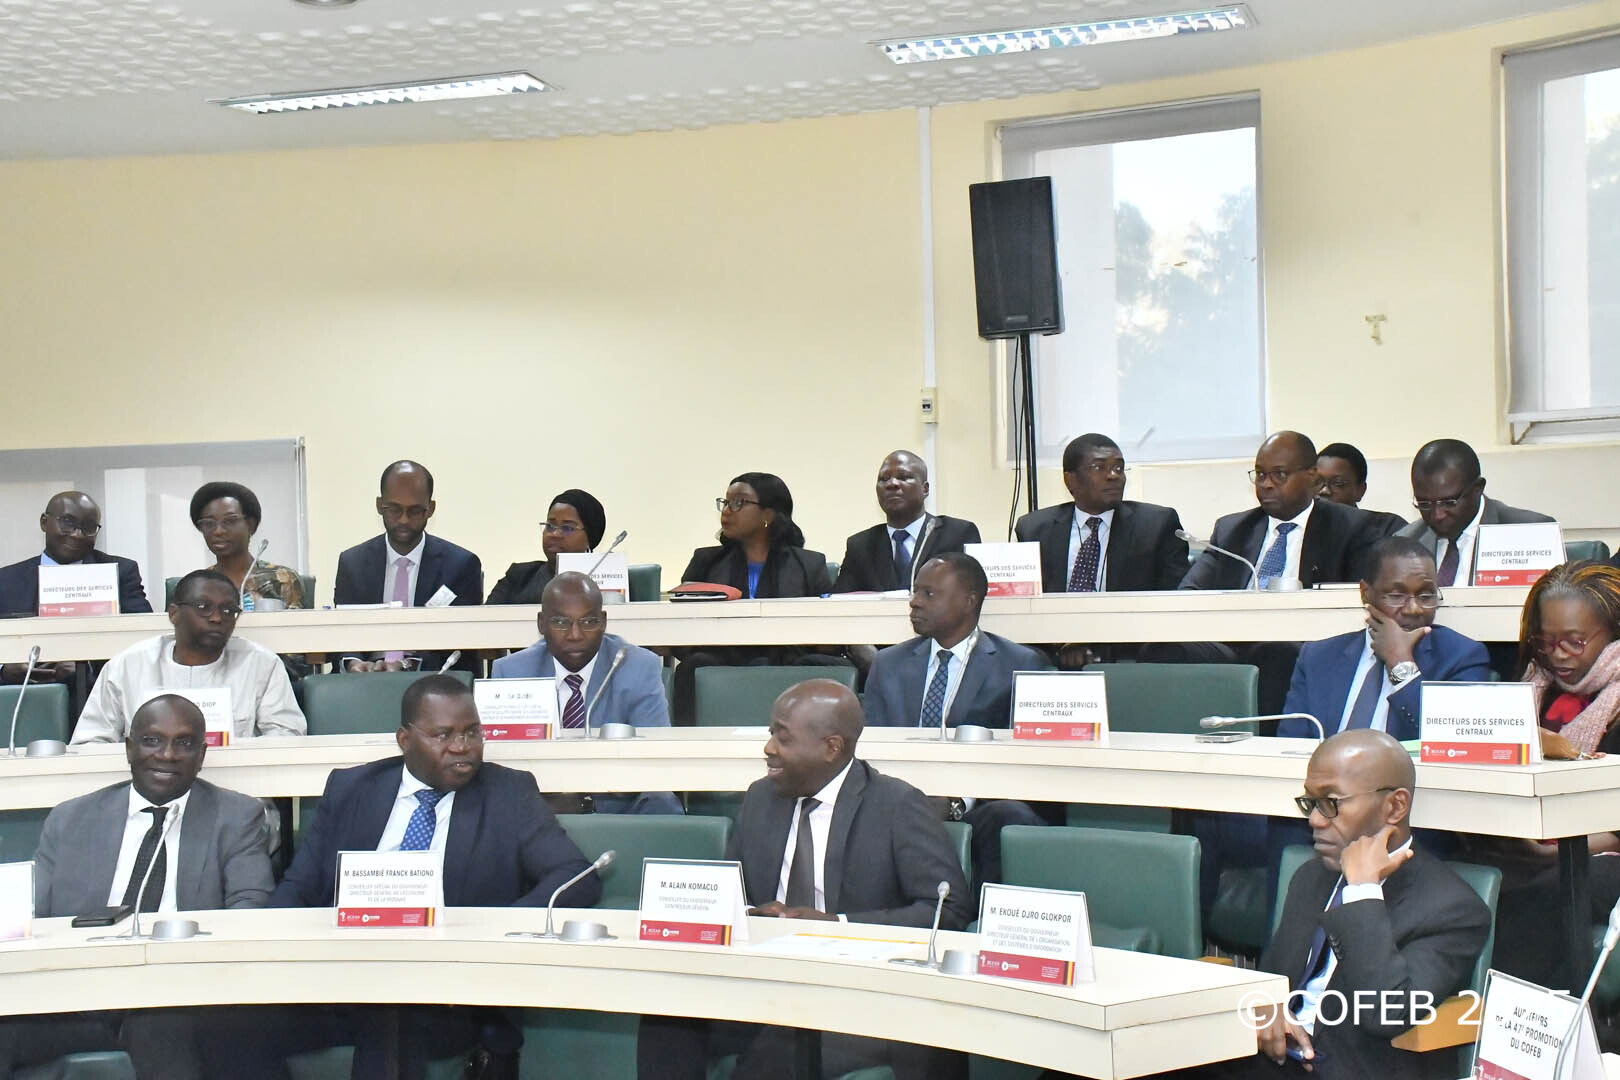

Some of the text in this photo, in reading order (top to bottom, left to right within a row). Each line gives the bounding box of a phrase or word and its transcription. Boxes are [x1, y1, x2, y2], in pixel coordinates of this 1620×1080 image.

[1018, 701, 1098, 709] DIRECTEURS DES SERVICES
[1426, 717, 1525, 726] DIRECTEURS DES SERVICES
[1455, 728, 1494, 736] CENTRAUX
[386, 869, 408, 877] FRANCK
[409, 869, 434, 877] BATIONO
[669, 881, 687, 889] ALAIN
[688, 882, 719, 891] KOMACLO
[999, 907, 1020, 917] EKOUÉ
[1021, 910, 1039, 920] DJRO
[1041, 912, 1072, 923] GLOKPOR
[1510, 1037, 1542, 1058] DU COFEB
